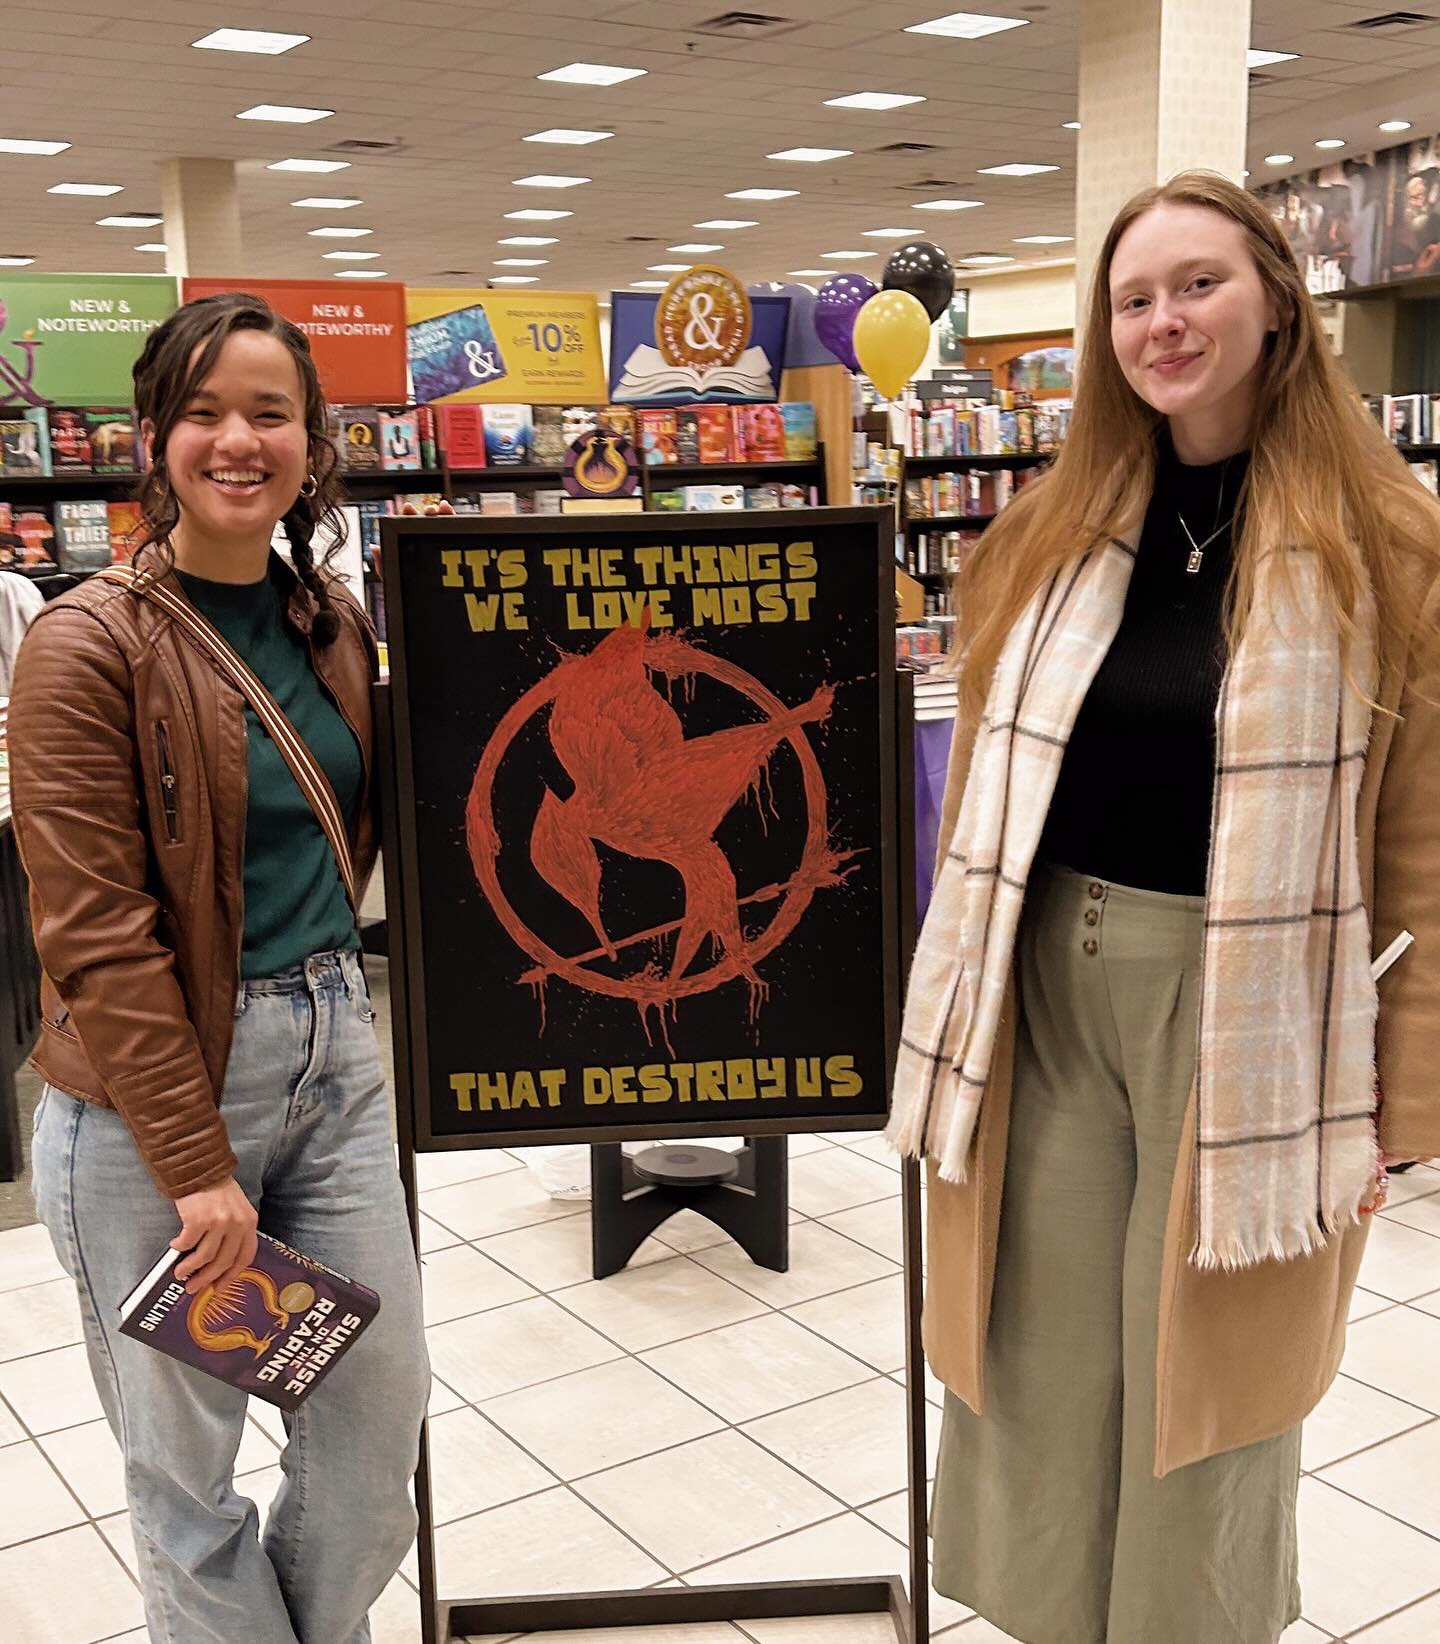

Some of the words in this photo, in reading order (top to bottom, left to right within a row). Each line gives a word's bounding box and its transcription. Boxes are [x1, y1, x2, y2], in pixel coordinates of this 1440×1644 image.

[69, 299, 113, 313] NEW
[117, 300, 131, 313] &
[312, 304, 350, 318] NEW
[353, 304, 365, 318] &
[684, 292, 726, 351] &
[295, 322, 394, 336] OTEWORTHY
[563, 343, 585, 353] OFF
[464, 340, 501, 378] &
[63, 526, 108, 542] THIEF
[441, 549, 528, 588] IT'S
[543, 548, 627, 586] THE
[634, 541, 818, 585] THINGS
[465, 592, 529, 633] WE
[566, 589, 673, 630] LOVE
[692, 581, 817, 628] MOST
[449, 1069, 566, 1111] THAT
[583, 1057, 787, 1105] DESTROY
[795, 1055, 864, 1098] US
[139, 1282, 185, 1332] COLLINS
[256, 1297, 337, 1383] REAPING
[285, 1312, 362, 1395] SUNRISE
[310, 1327, 330, 1345] ON
[289, 1346, 315, 1369] THE
